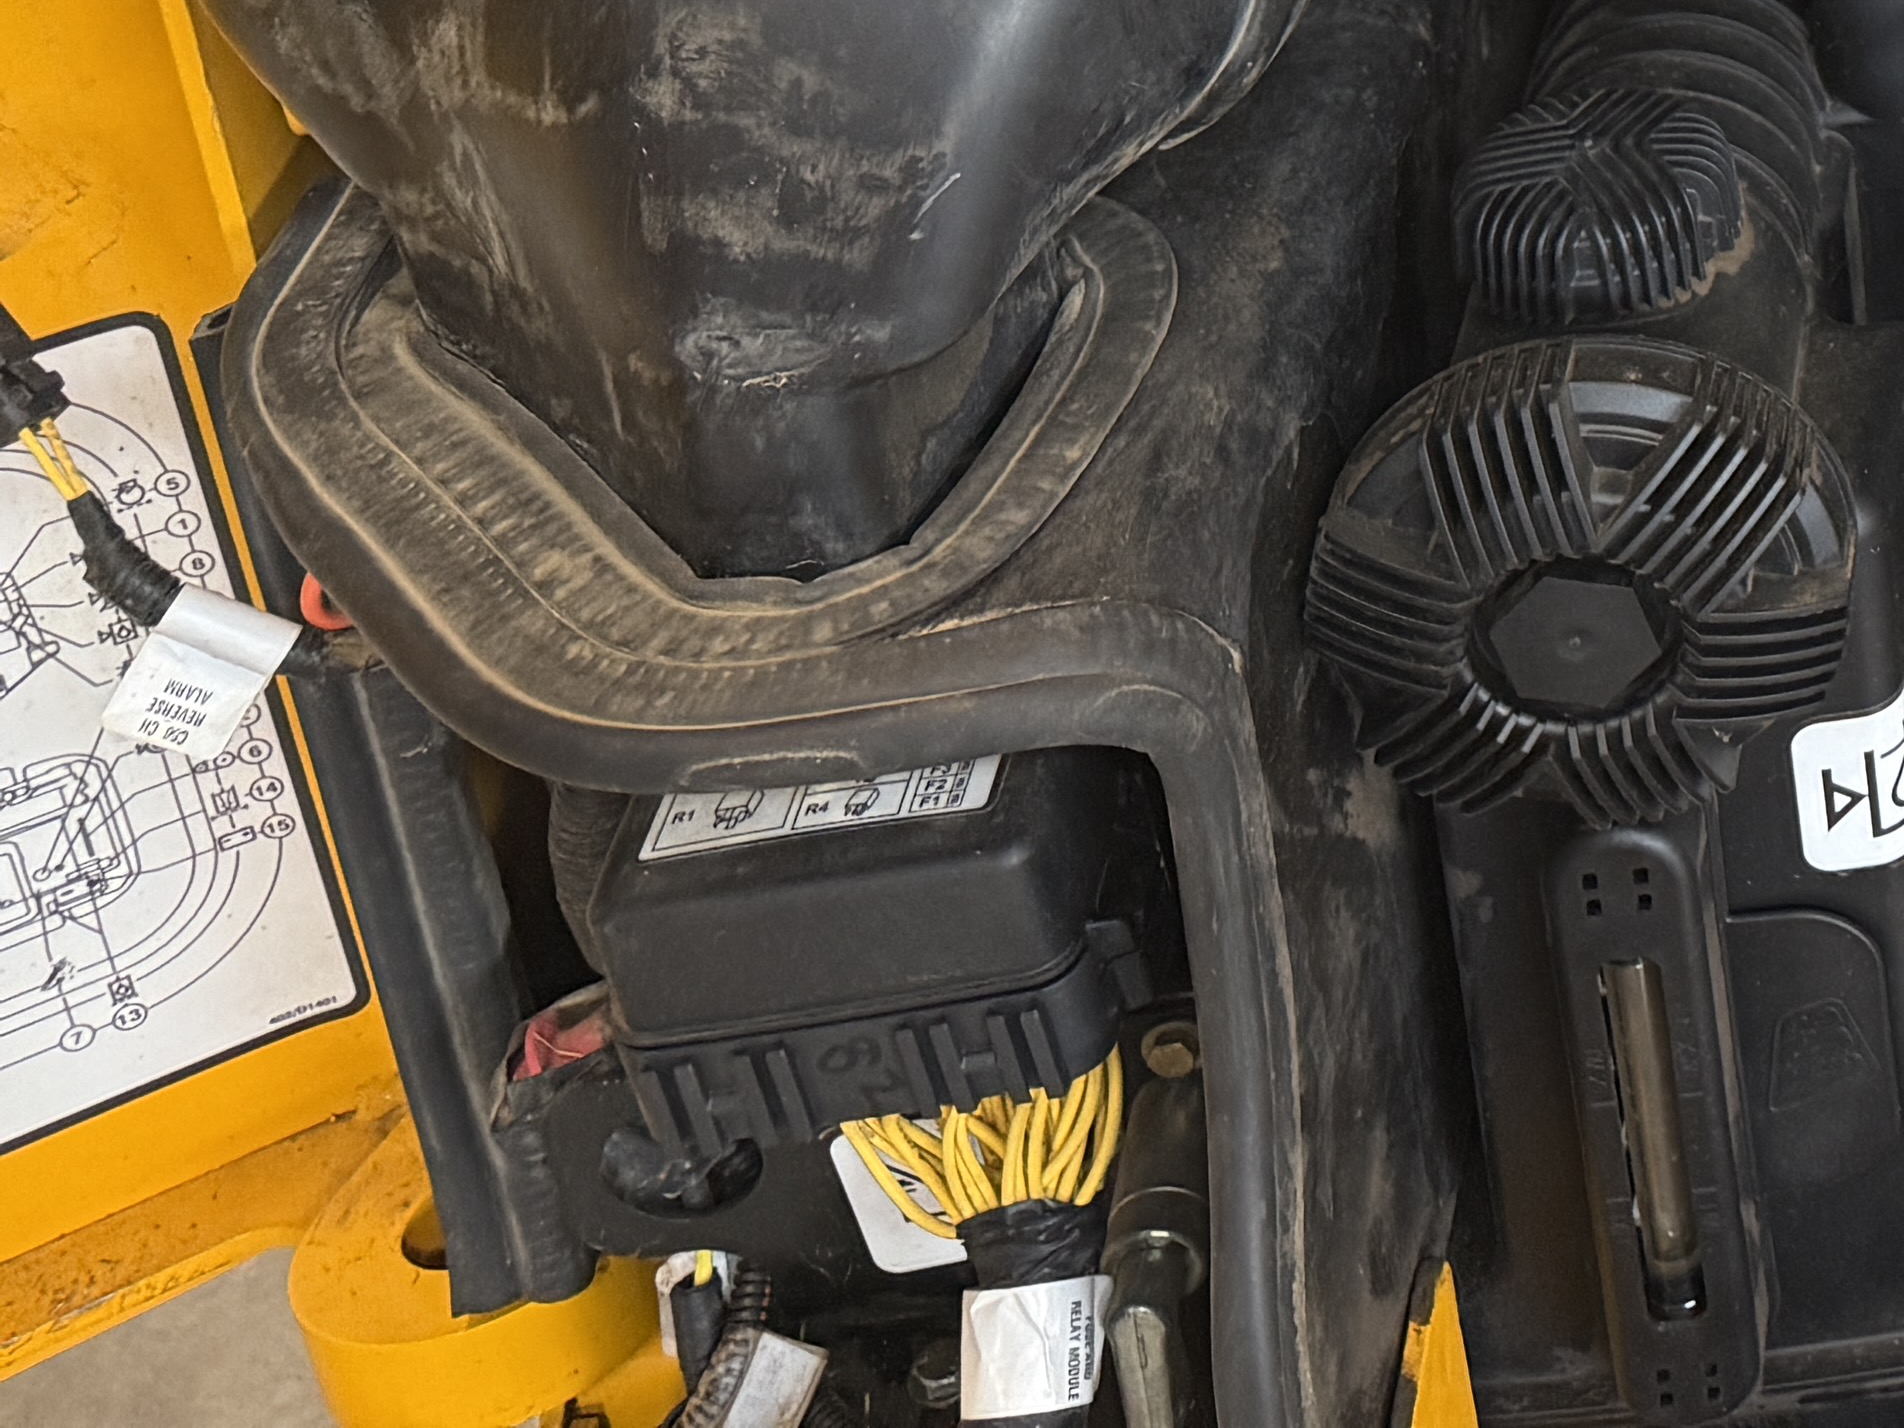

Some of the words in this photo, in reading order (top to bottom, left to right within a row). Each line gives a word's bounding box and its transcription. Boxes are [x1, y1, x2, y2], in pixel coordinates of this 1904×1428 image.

[162, 677, 214, 706] ALARM
[145, 696, 208, 729] REVERSE
[670, 808, 697, 826] R1
[803, 800, 831, 818] R4
[1069, 1300, 1083, 1343] RELAY
[1067, 1346, 1081, 1402] MODULE
